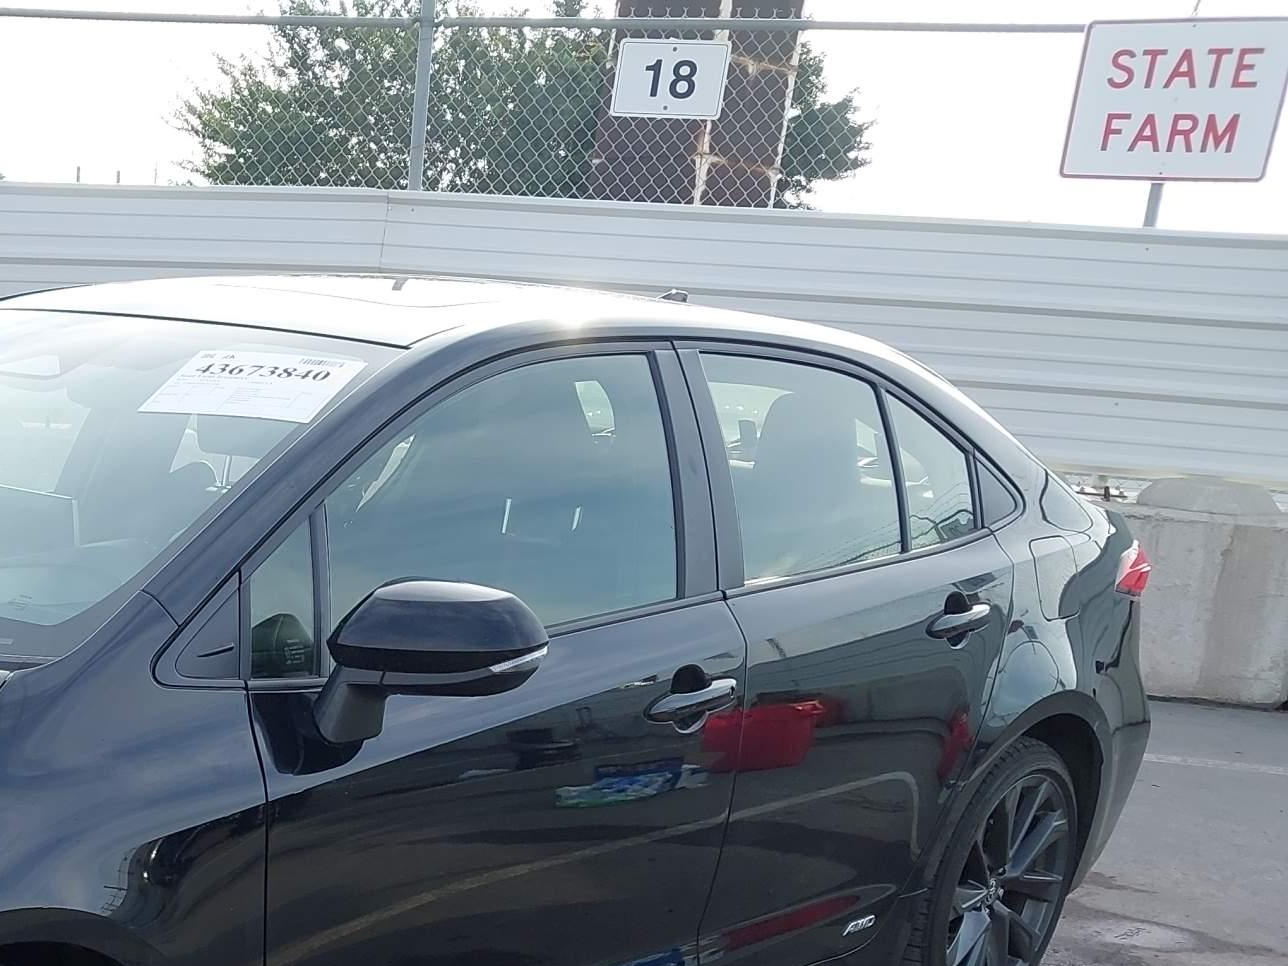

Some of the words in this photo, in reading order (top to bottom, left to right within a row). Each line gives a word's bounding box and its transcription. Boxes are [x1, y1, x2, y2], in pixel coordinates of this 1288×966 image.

[645, 58, 698, 100] 18
[1106, 47, 1265, 90] STATE
[1099, 112, 1241, 154] FARM
[195, 361, 332, 382] 43673840
